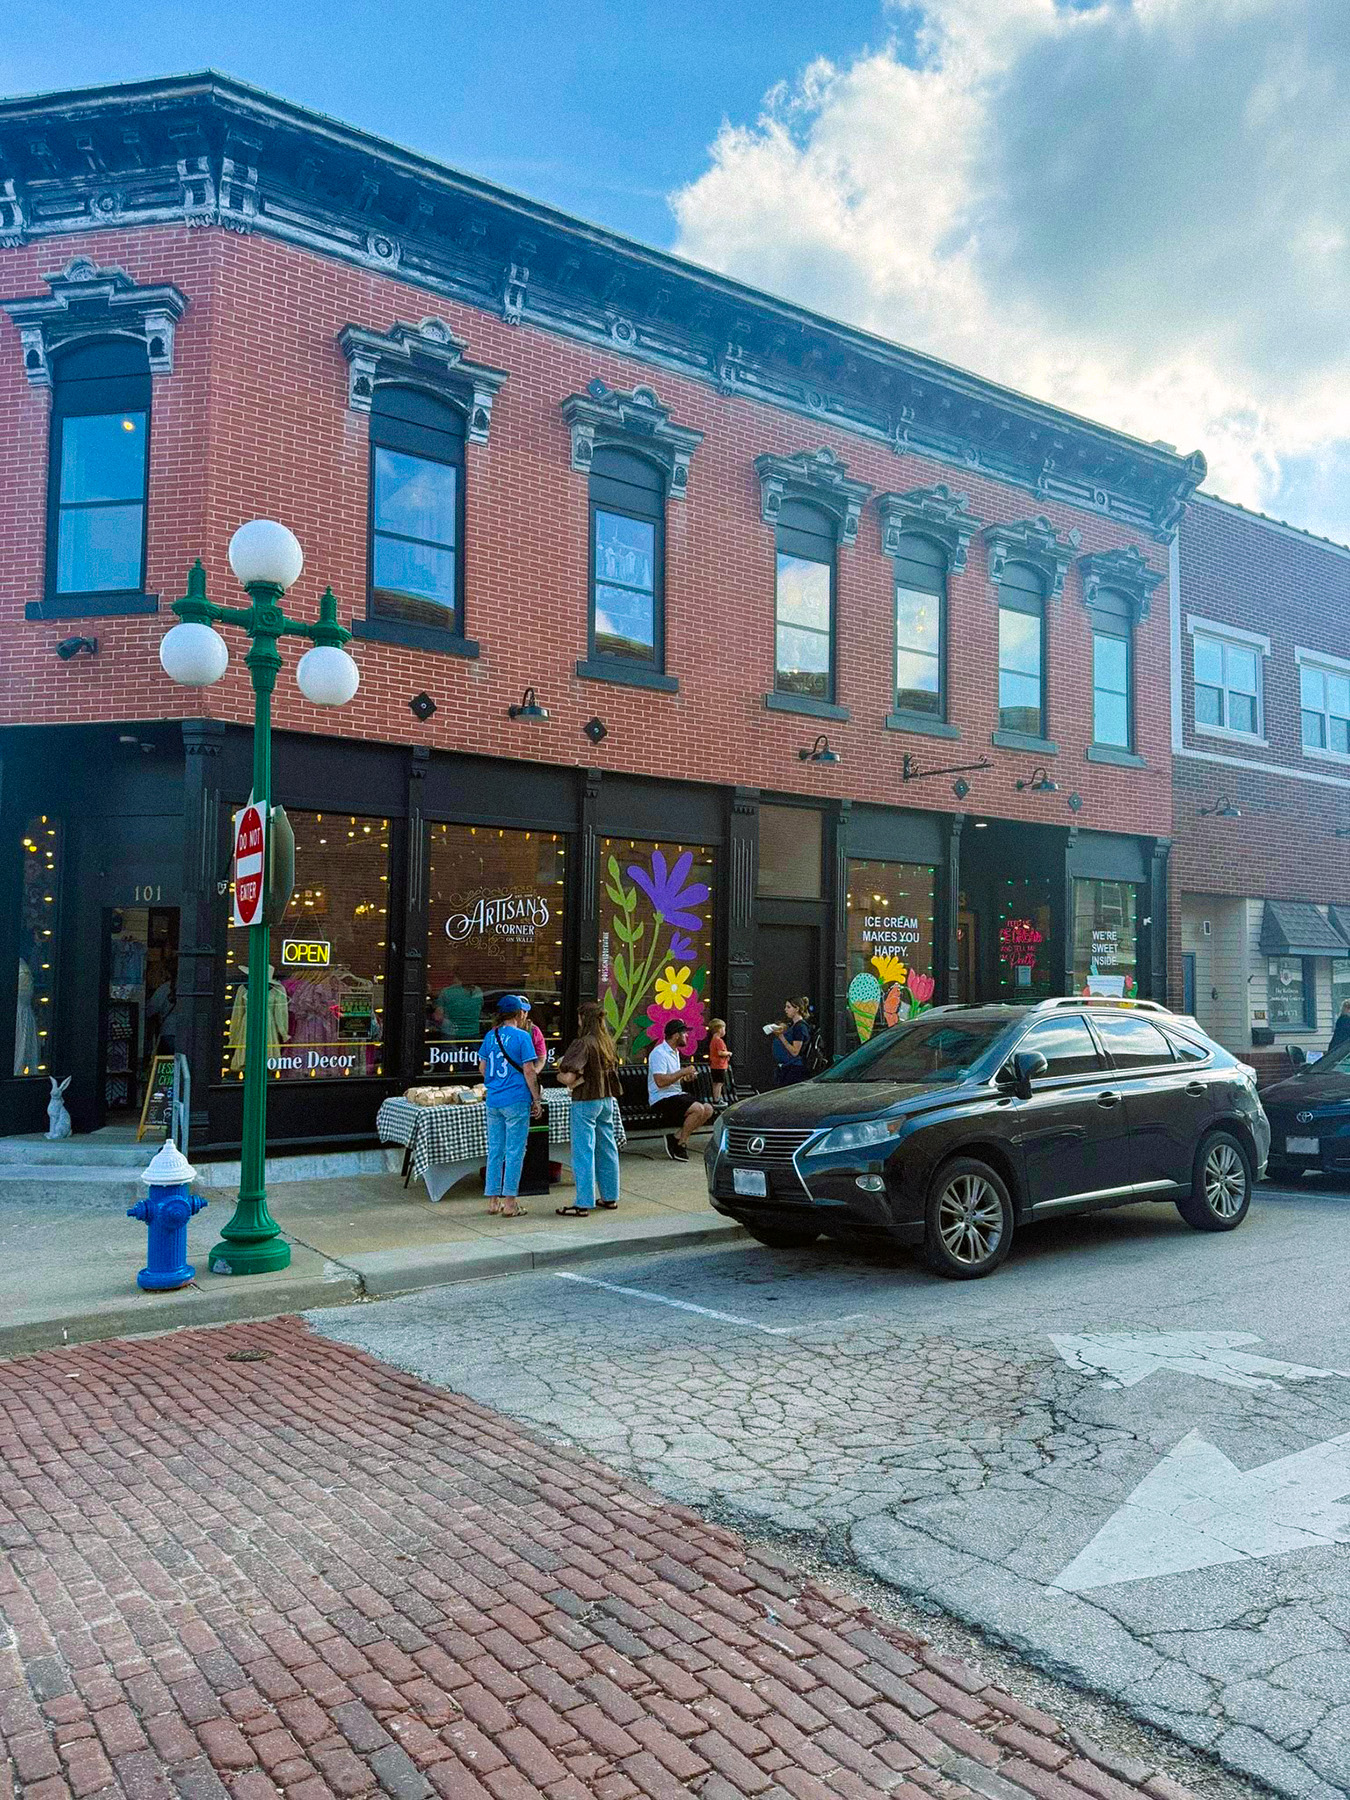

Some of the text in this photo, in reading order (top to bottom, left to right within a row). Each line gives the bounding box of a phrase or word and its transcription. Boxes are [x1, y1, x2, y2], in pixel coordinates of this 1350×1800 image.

[239, 827, 261, 852] DO NOT
[135, 885, 161, 902] 101
[239, 881, 257, 901] ENTER
[495, 923, 535, 936] CORNER
[864, 916, 918, 929] ICE CREAM
[862, 930, 920, 943] MAKES YOU
[1092, 930, 1117, 941] WE'RE
[284, 943, 329, 963] OPEN
[874, 945, 909, 957] HAPPY.
[1091, 943, 1119, 953] SWEET
[1091, 955, 1119, 966] INSIDE.
[267, 1050, 356, 1070] ome Decor
[429, 1046, 479, 1066] Boutiq
[488, 1050, 509, 1078] 13
